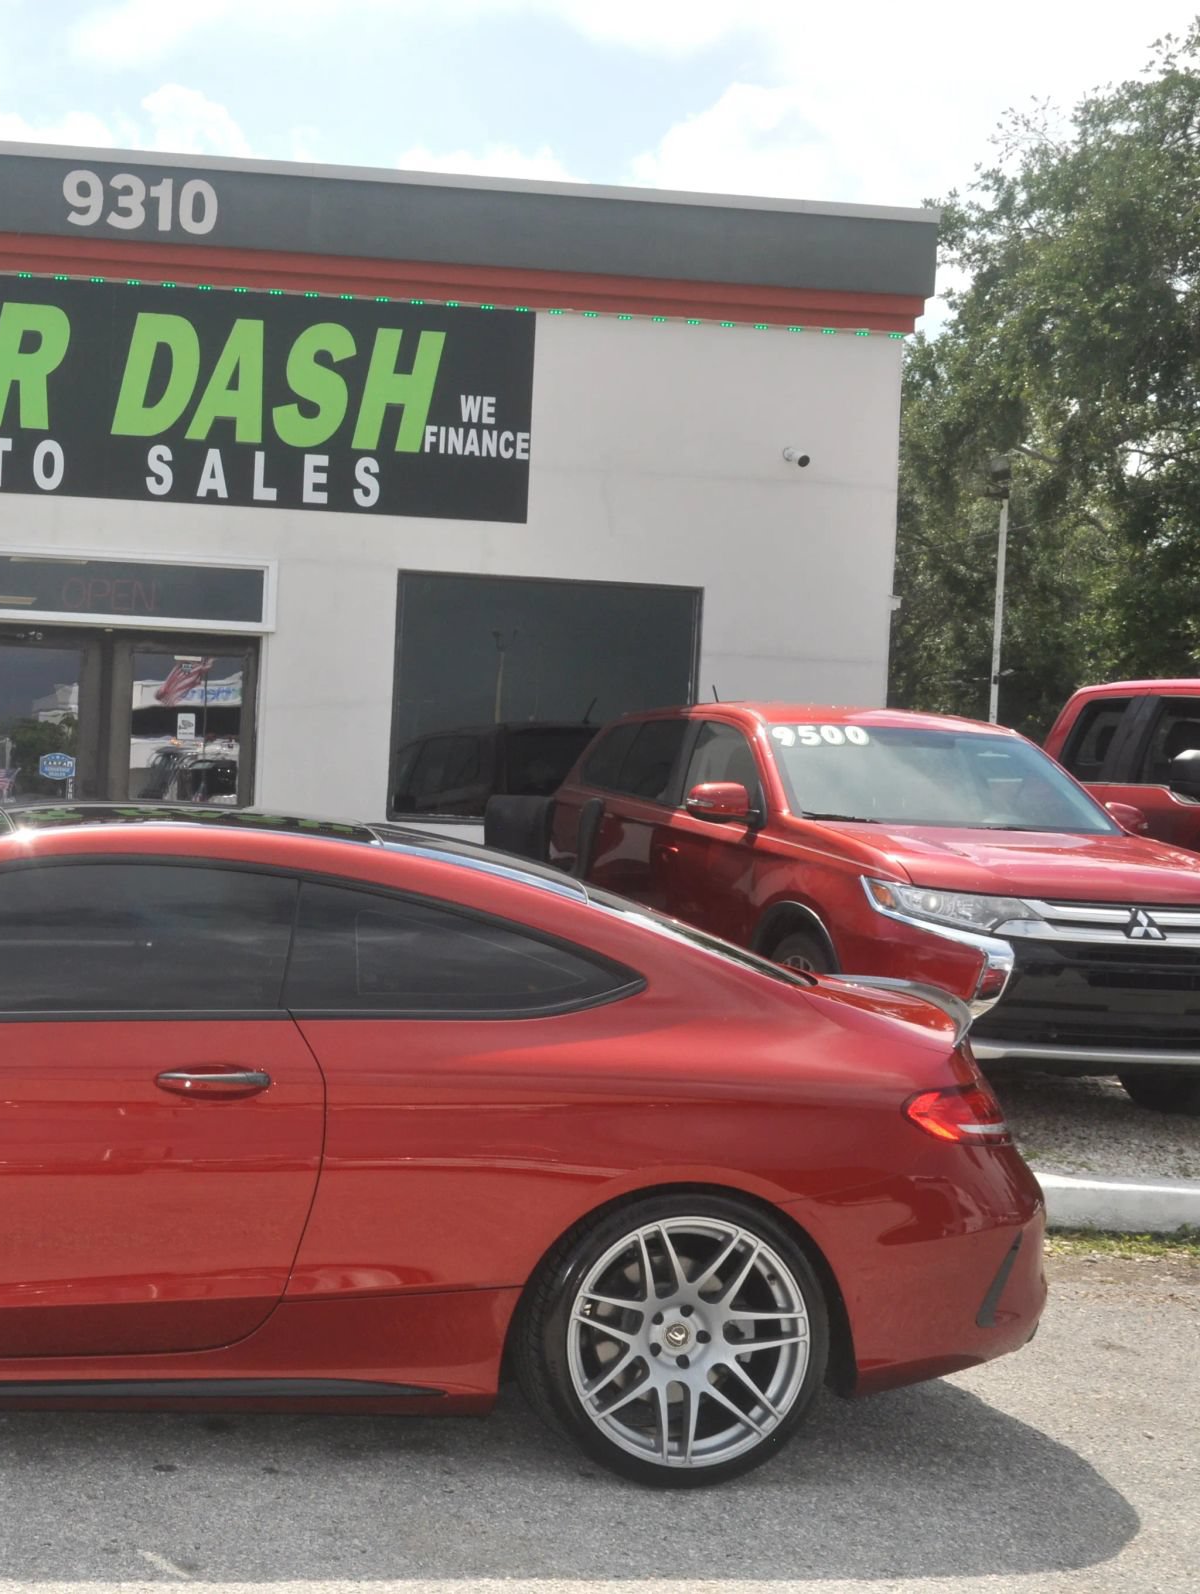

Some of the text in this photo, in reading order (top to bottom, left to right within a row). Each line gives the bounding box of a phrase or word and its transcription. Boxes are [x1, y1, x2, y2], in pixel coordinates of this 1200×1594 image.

[62, 169, 218, 235] 9310
[112, 312, 446, 453] DASH
[460, 394, 497, 425] WE
[424, 424, 531, 461] FINANCE
[144, 444, 381, 509] SALES
[62, 576, 156, 612] OPEN
[771, 724, 870, 747] 9500
